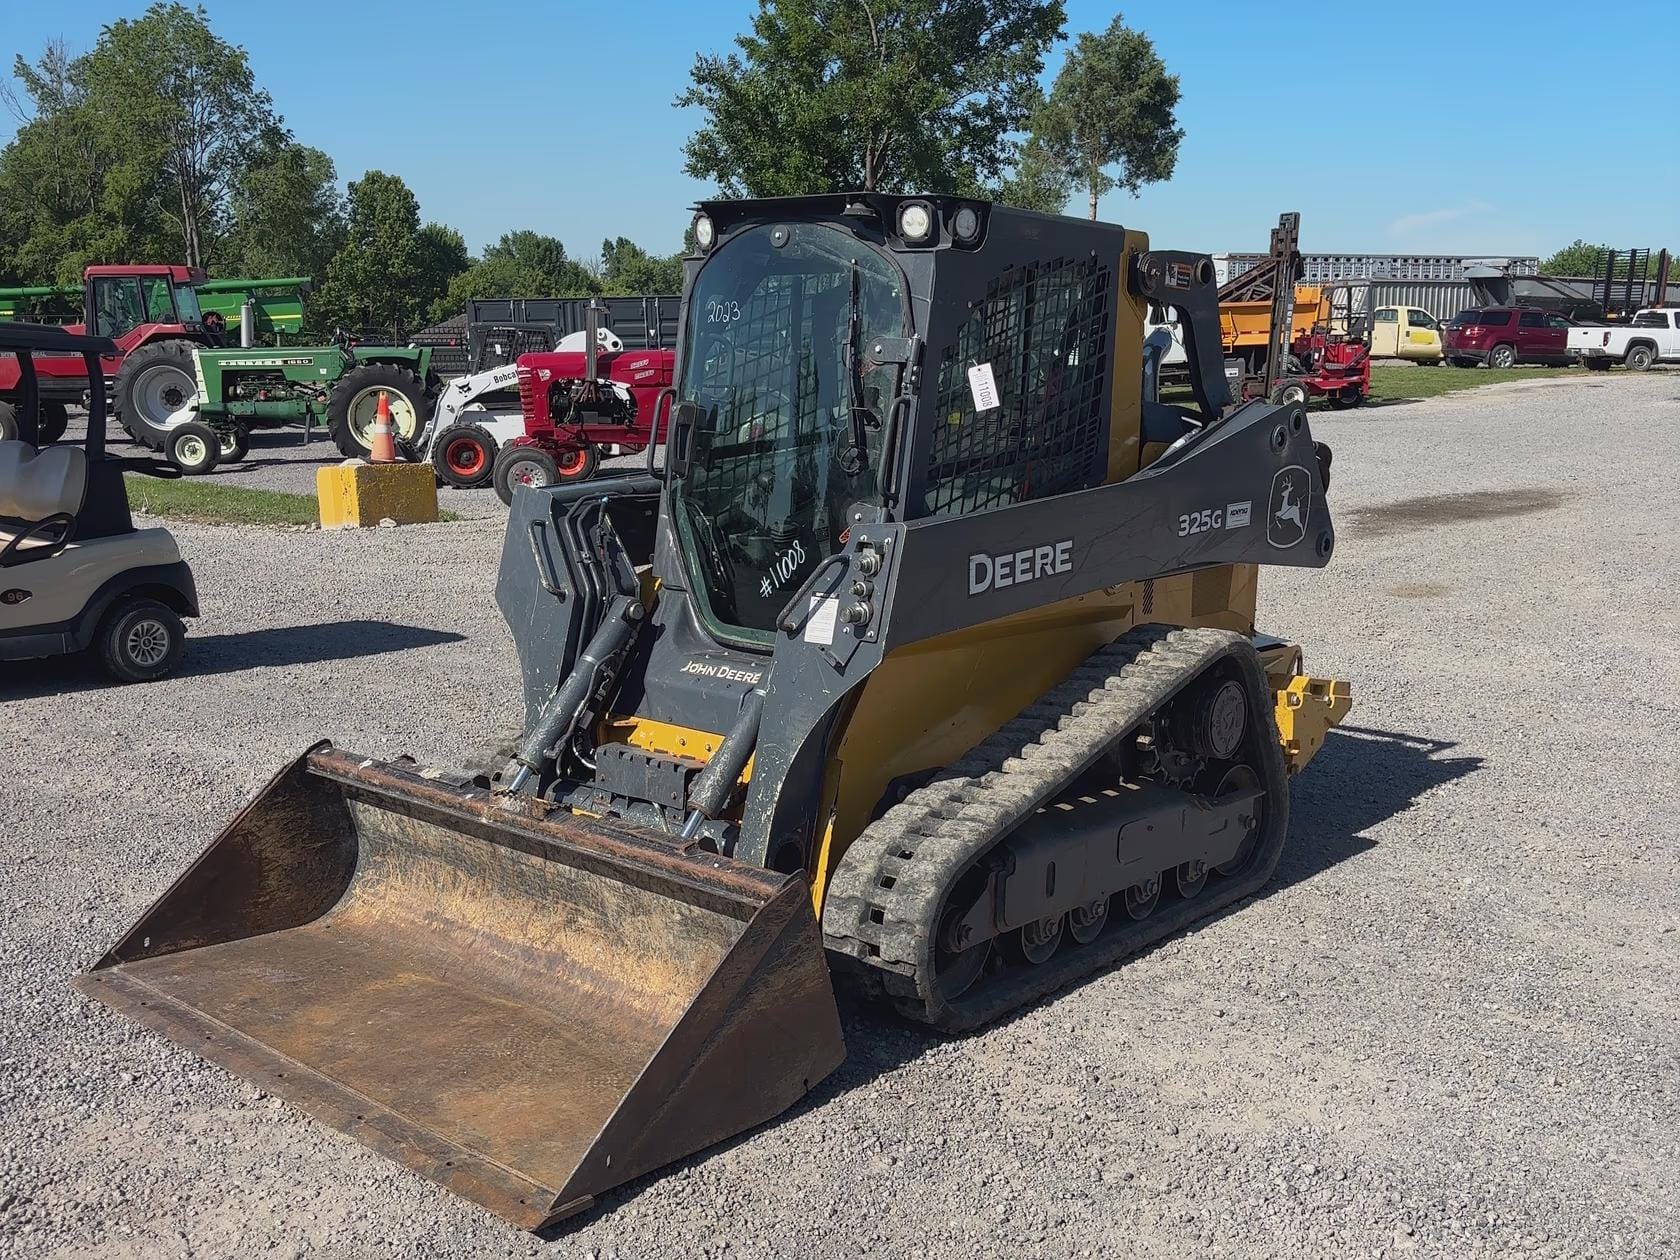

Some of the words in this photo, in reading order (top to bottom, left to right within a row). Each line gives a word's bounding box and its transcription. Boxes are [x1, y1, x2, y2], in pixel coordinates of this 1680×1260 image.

[707, 300, 741, 323] 2023
[977, 381, 993, 408] 11008
[1178, 509, 1223, 537] 325G
[759, 539, 806, 598] #11008
[969, 539, 1073, 595] DEERE
[7, 591, 24, 602] 96
[679, 660, 718, 677] JOHN
[716, 666, 762, 684] DEERE
